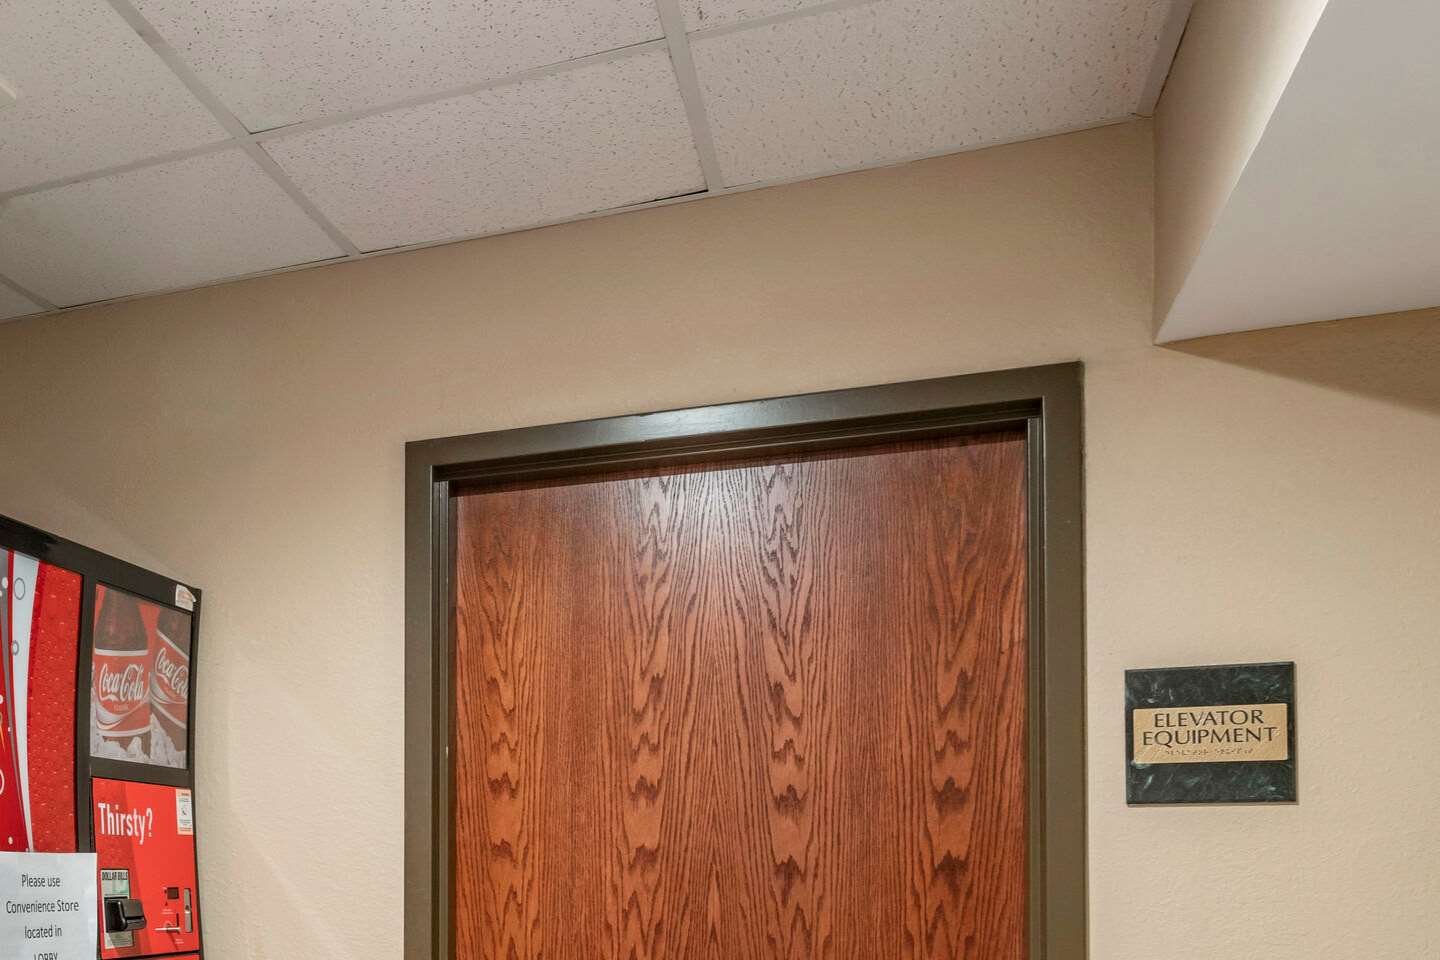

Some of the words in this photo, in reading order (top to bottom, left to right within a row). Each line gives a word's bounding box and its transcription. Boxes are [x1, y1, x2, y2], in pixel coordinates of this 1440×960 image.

[98, 663, 145, 702] Coca-Cola
[1153, 709, 1265, 728] ELEVATOR
[1142, 727, 1278, 748] EQUIPMENT
[98, 802, 153, 845] Thirsty?
[21, 873, 46, 888] Please
[47, 878, 61, 888] use
[5, 900, 55, 914] Convenience
[56, 899, 80, 913] Store
[24, 925, 53, 939] located
[54, 924, 63, 937] in
